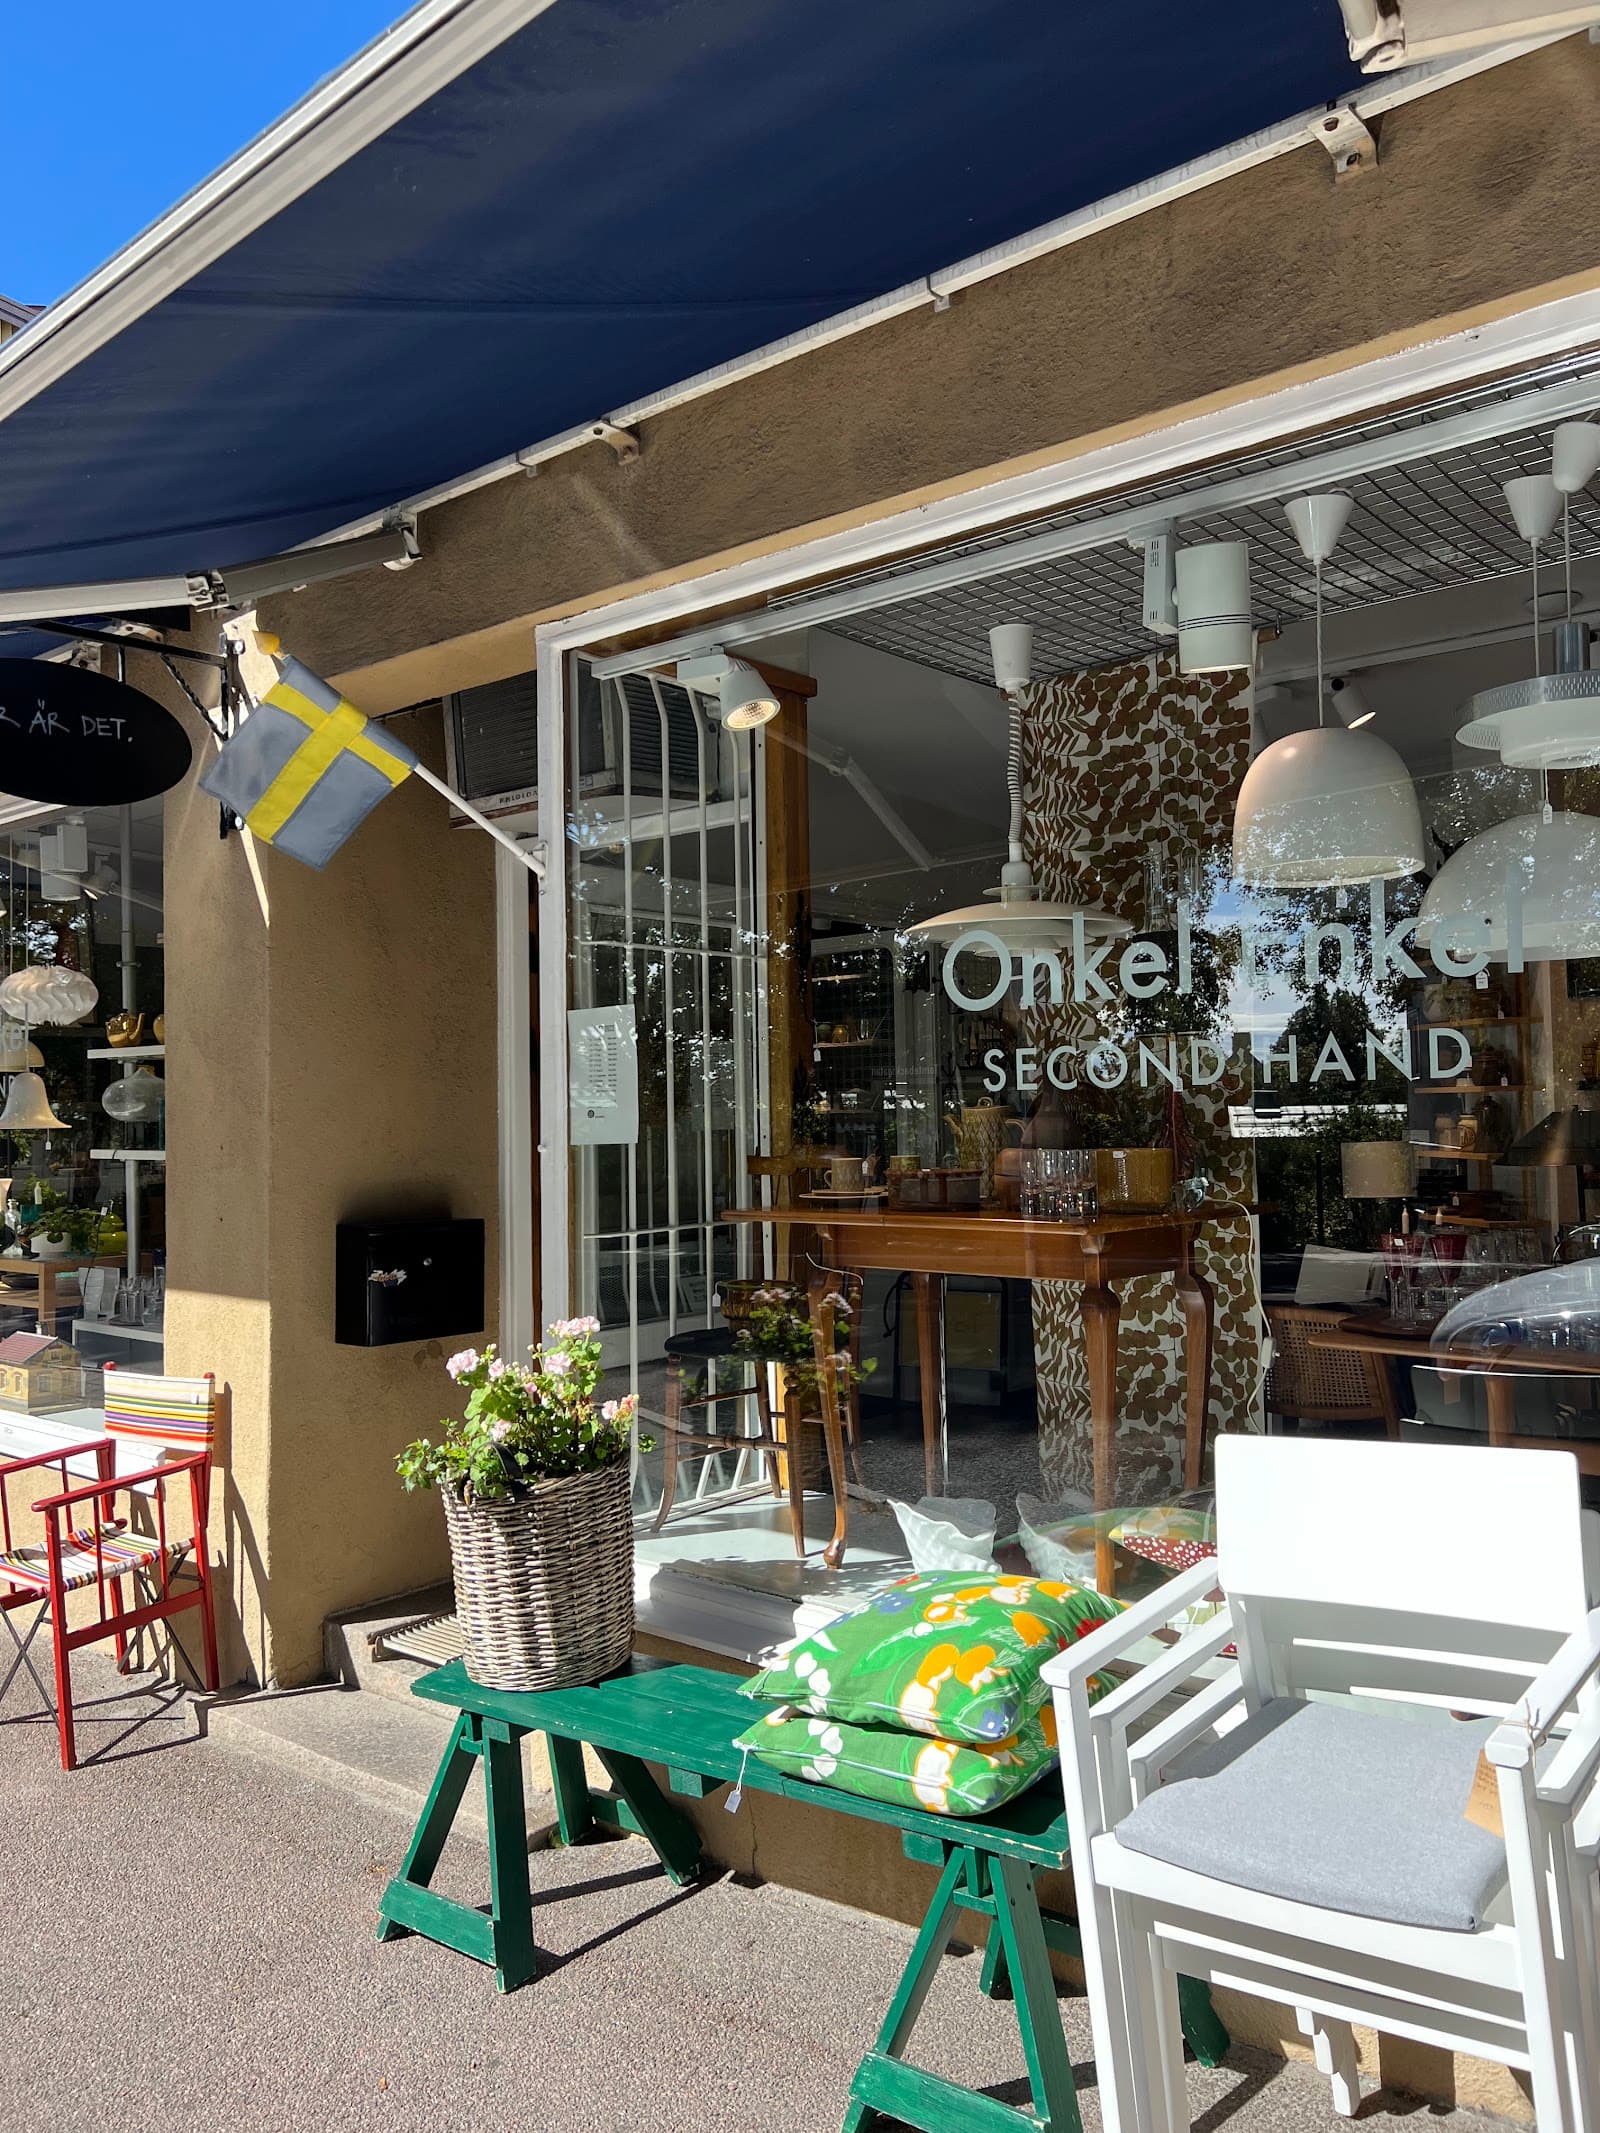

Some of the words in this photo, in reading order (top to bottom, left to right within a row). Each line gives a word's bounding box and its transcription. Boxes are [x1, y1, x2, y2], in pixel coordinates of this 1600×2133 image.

[29, 698, 70, 735] ÄR
[81, 715, 133, 742] DET.
[943, 898, 1192, 1012] Onkel
[1241, 861, 1525, 991] Enkel
[983, 1039, 1226, 1092] SECOND
[1262, 1027, 1471, 1083] HAND
